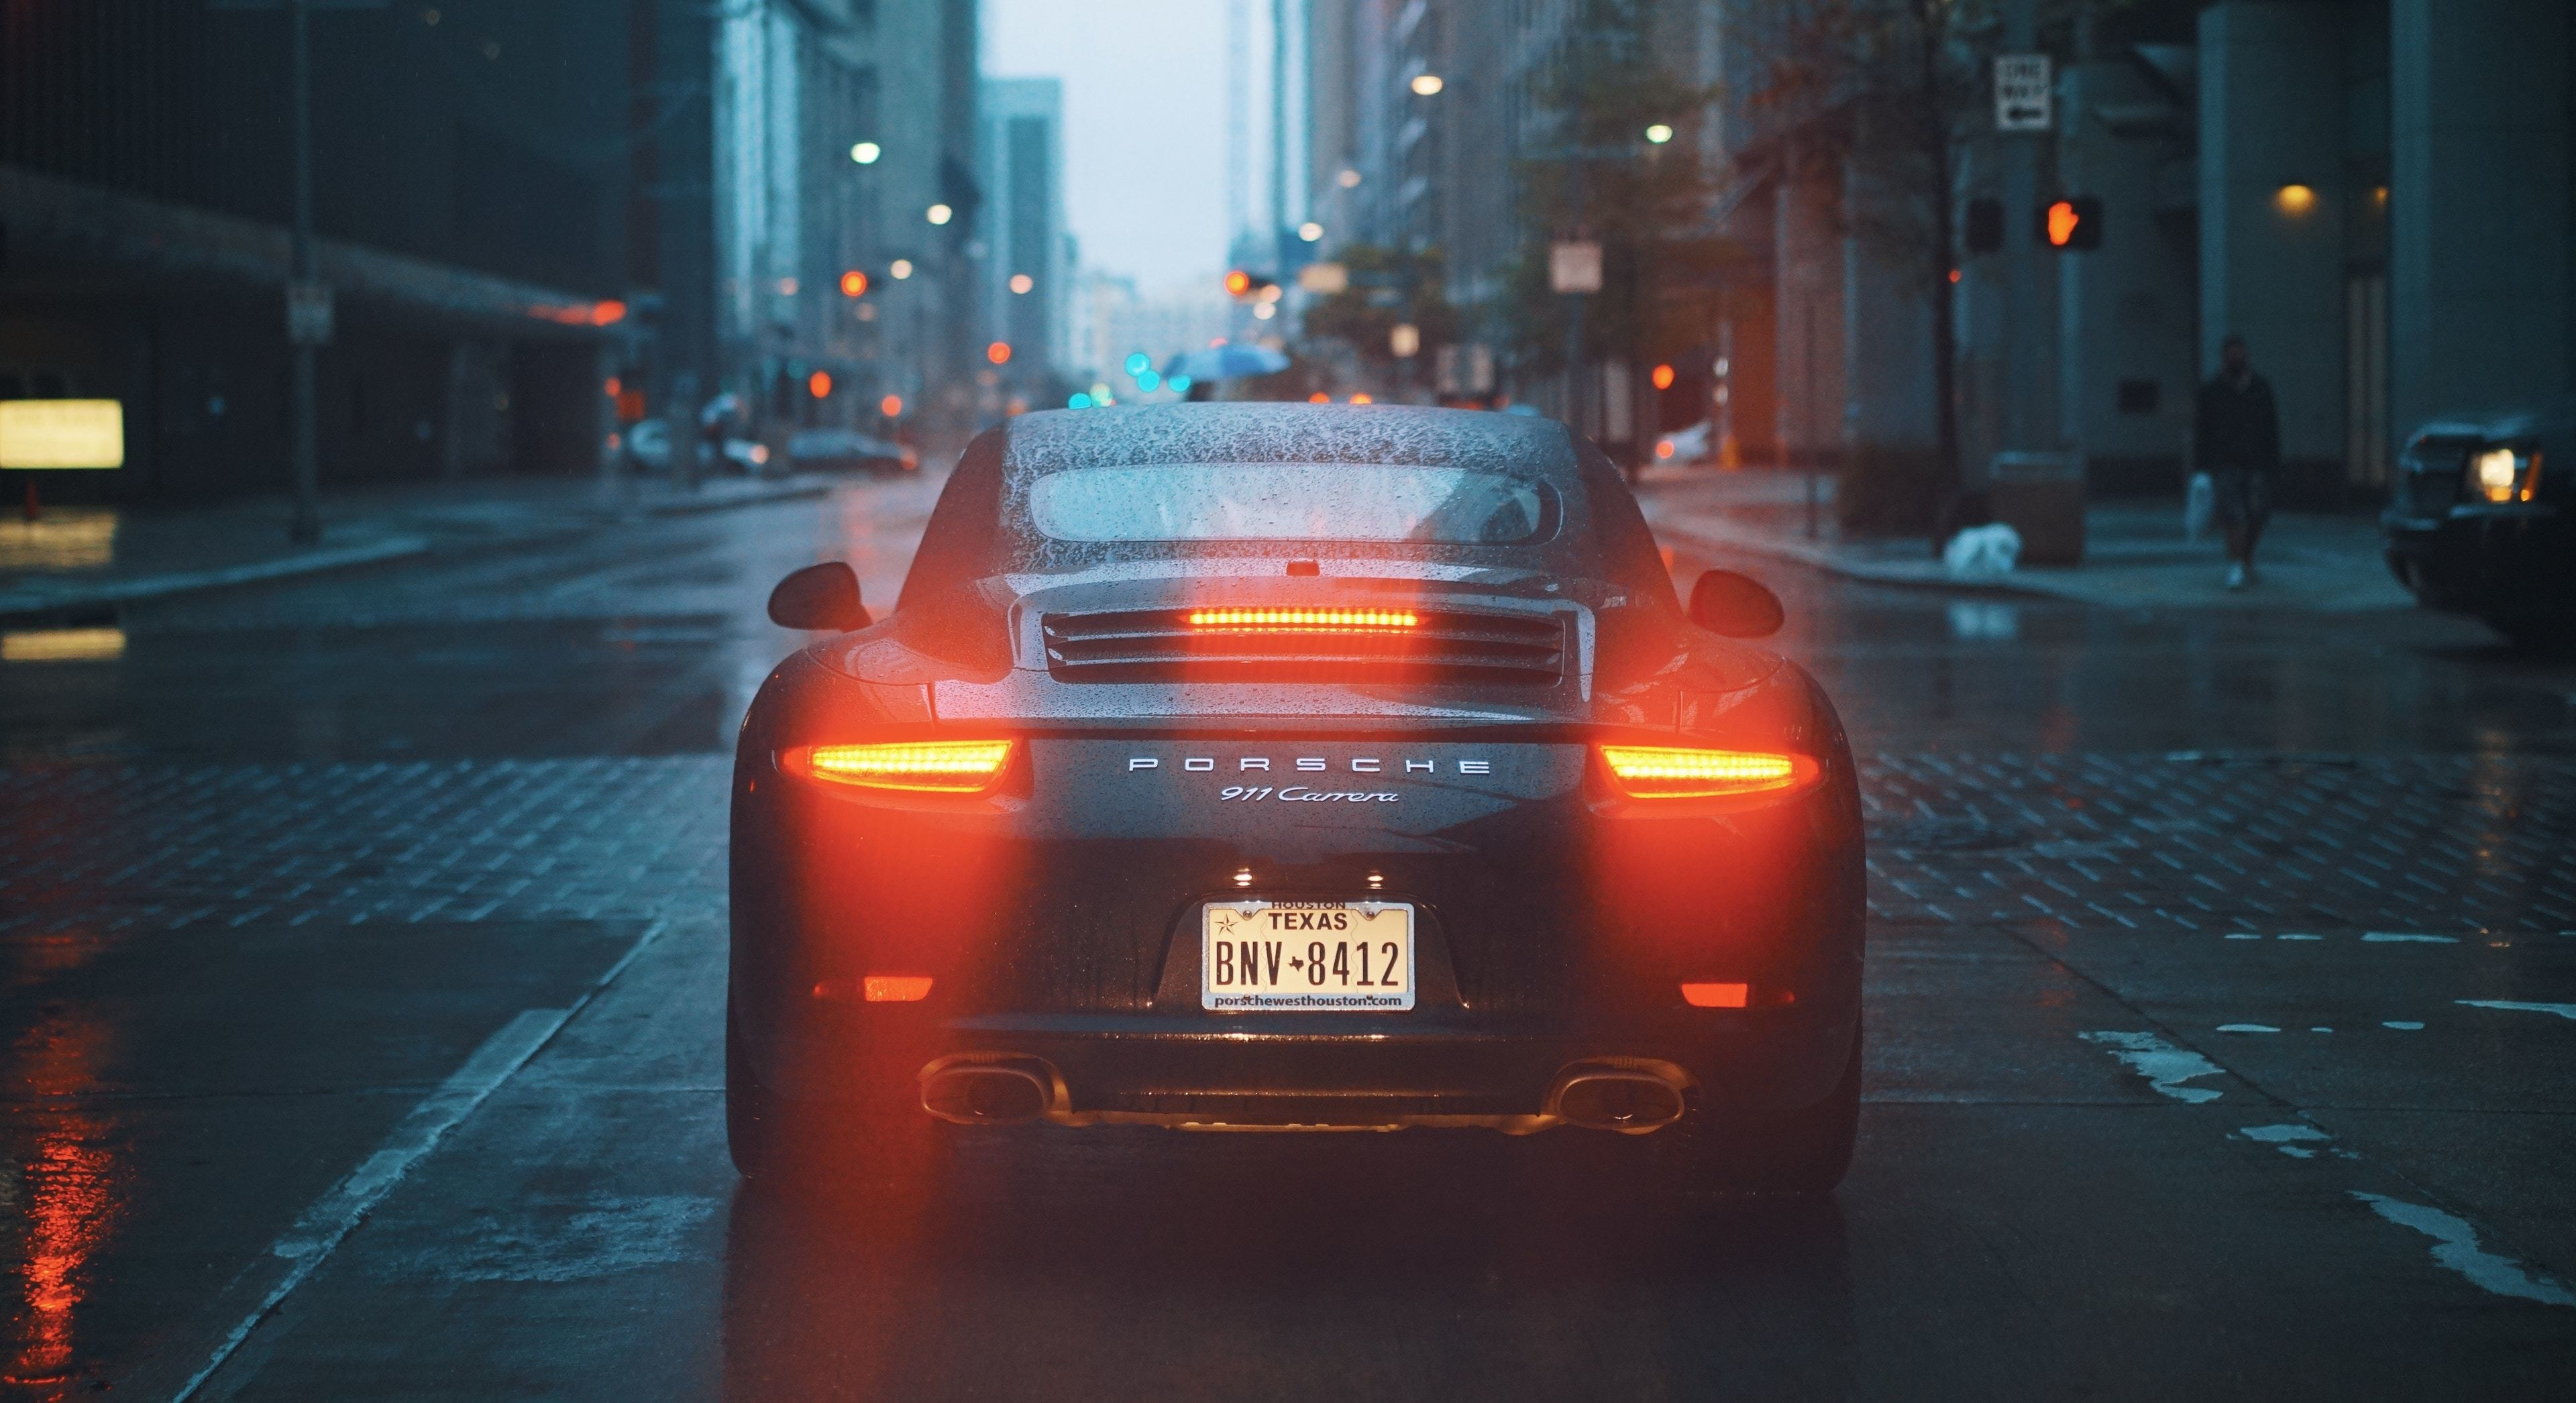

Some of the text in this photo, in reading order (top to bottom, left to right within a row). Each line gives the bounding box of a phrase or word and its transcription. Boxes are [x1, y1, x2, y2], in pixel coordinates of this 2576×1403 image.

[2002, 62, 2042, 78] ONE
[2002, 84, 2045, 100] WAY
[1128, 758, 1490, 774] PORSCHE
[1220, 787, 1400, 803] 911 Carrera
[1268, 912, 1348, 930] TEXAS
[1215, 995, 1402, 1008] porschewesthouston.com
